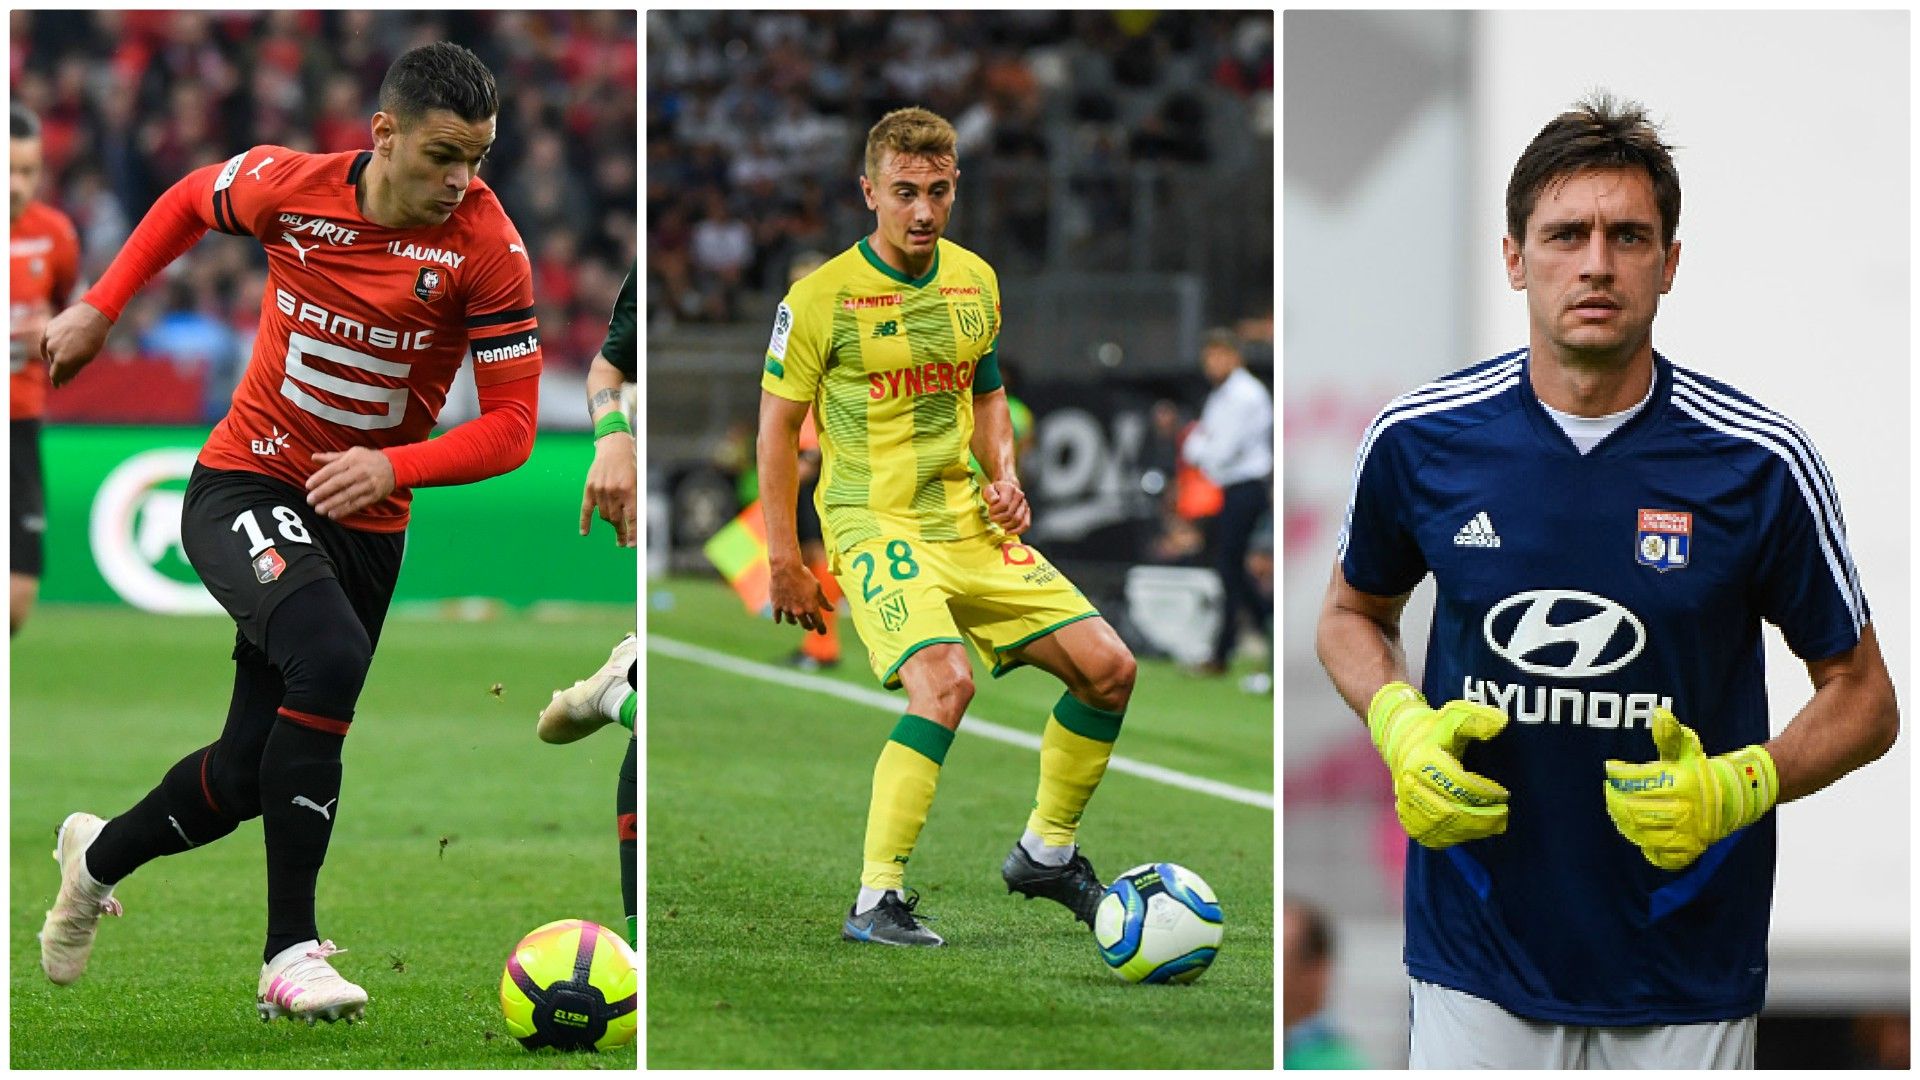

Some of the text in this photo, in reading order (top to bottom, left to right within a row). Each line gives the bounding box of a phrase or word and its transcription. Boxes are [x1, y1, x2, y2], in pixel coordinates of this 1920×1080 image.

[279, 213, 360, 247] DEL ARTE
[276, 288, 434, 350] SAMSIC
[476, 335, 538, 363] rennes.fr
[251, 439, 276, 456] ELA
[231, 505, 312, 558] 18
[1641, 534, 1685, 564] OL
[852, 539, 920, 603] 28
[554, 1008, 589, 1023] ELYSIA
